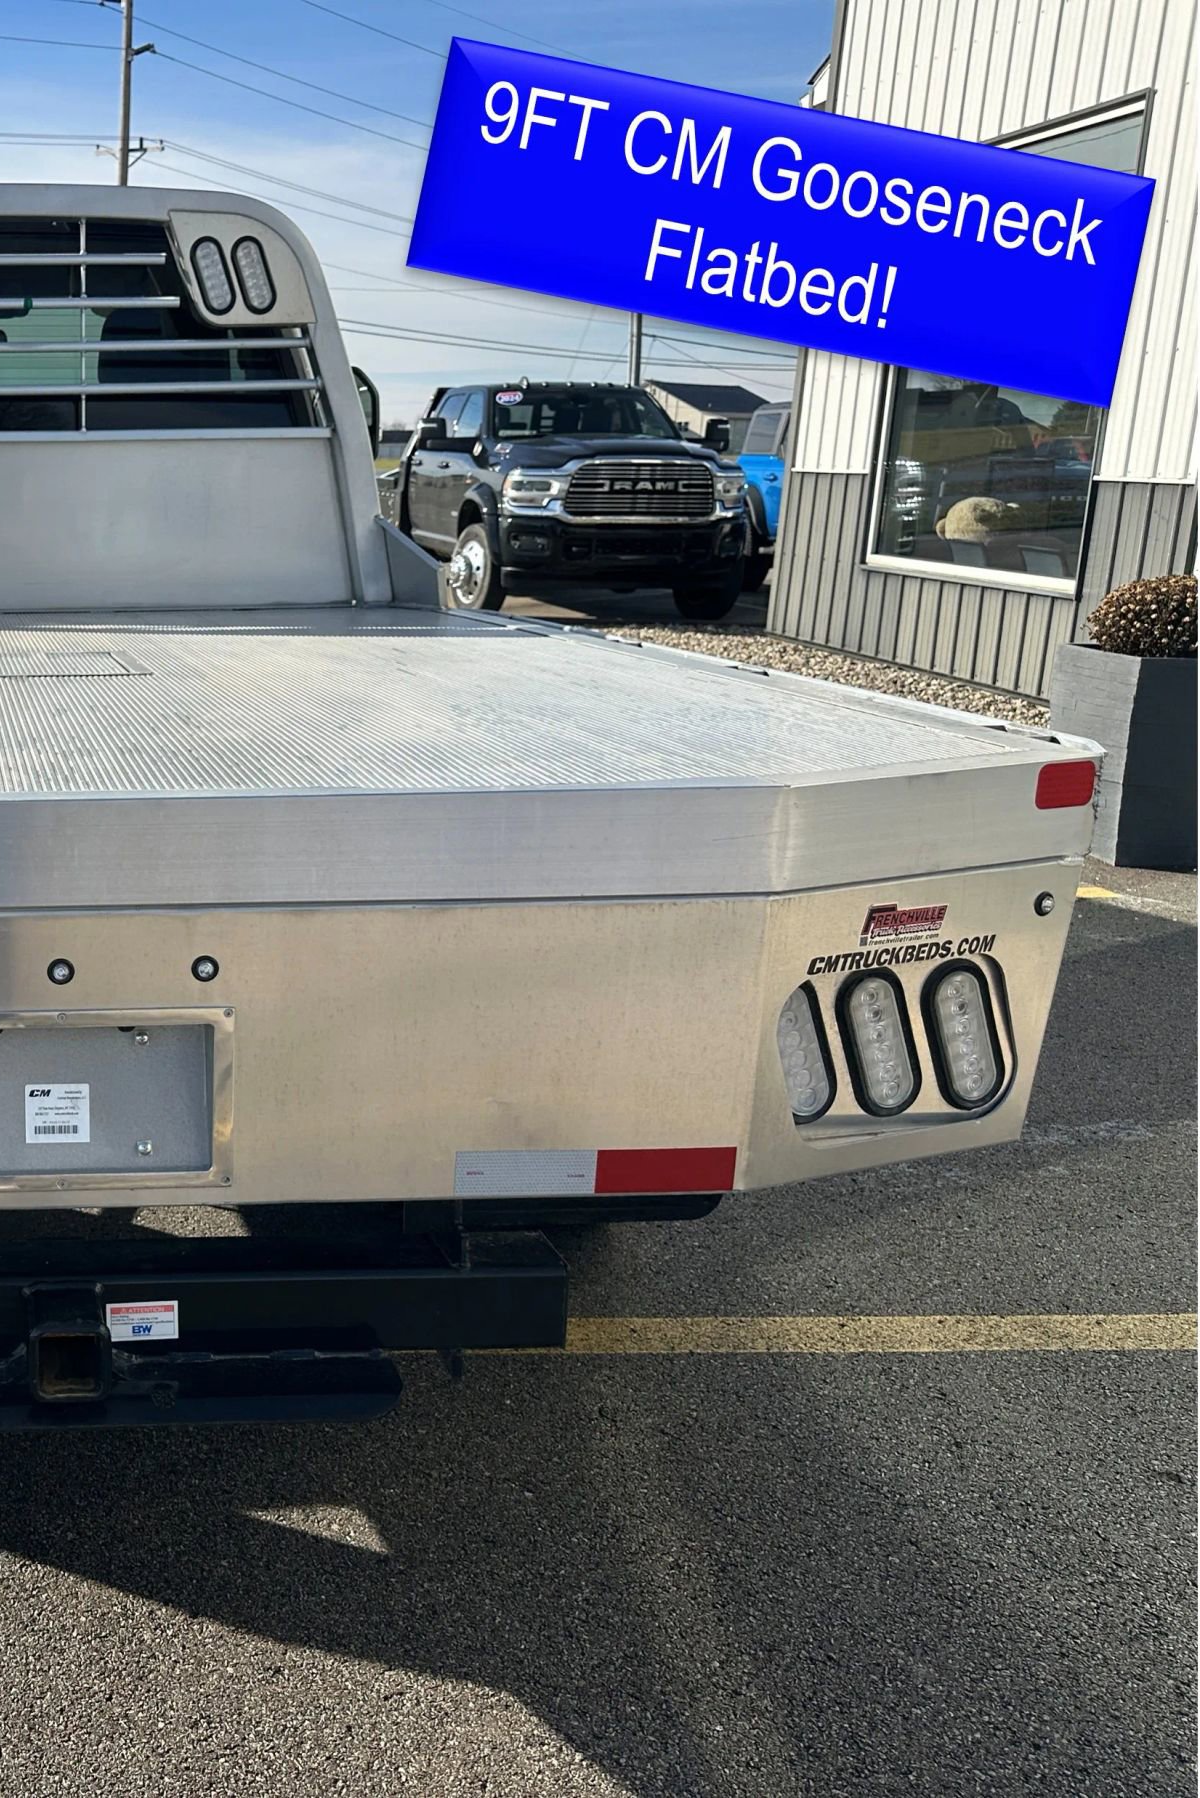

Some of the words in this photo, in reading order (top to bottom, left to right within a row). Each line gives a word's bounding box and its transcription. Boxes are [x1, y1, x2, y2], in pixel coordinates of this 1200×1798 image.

[613, 481, 675, 490] RAM
[861, 904, 947, 935] FRENCHVILLE
[807, 934, 996, 975] CMTRUCKBEDS.COM
[29, 1089, 51, 1098] CM
